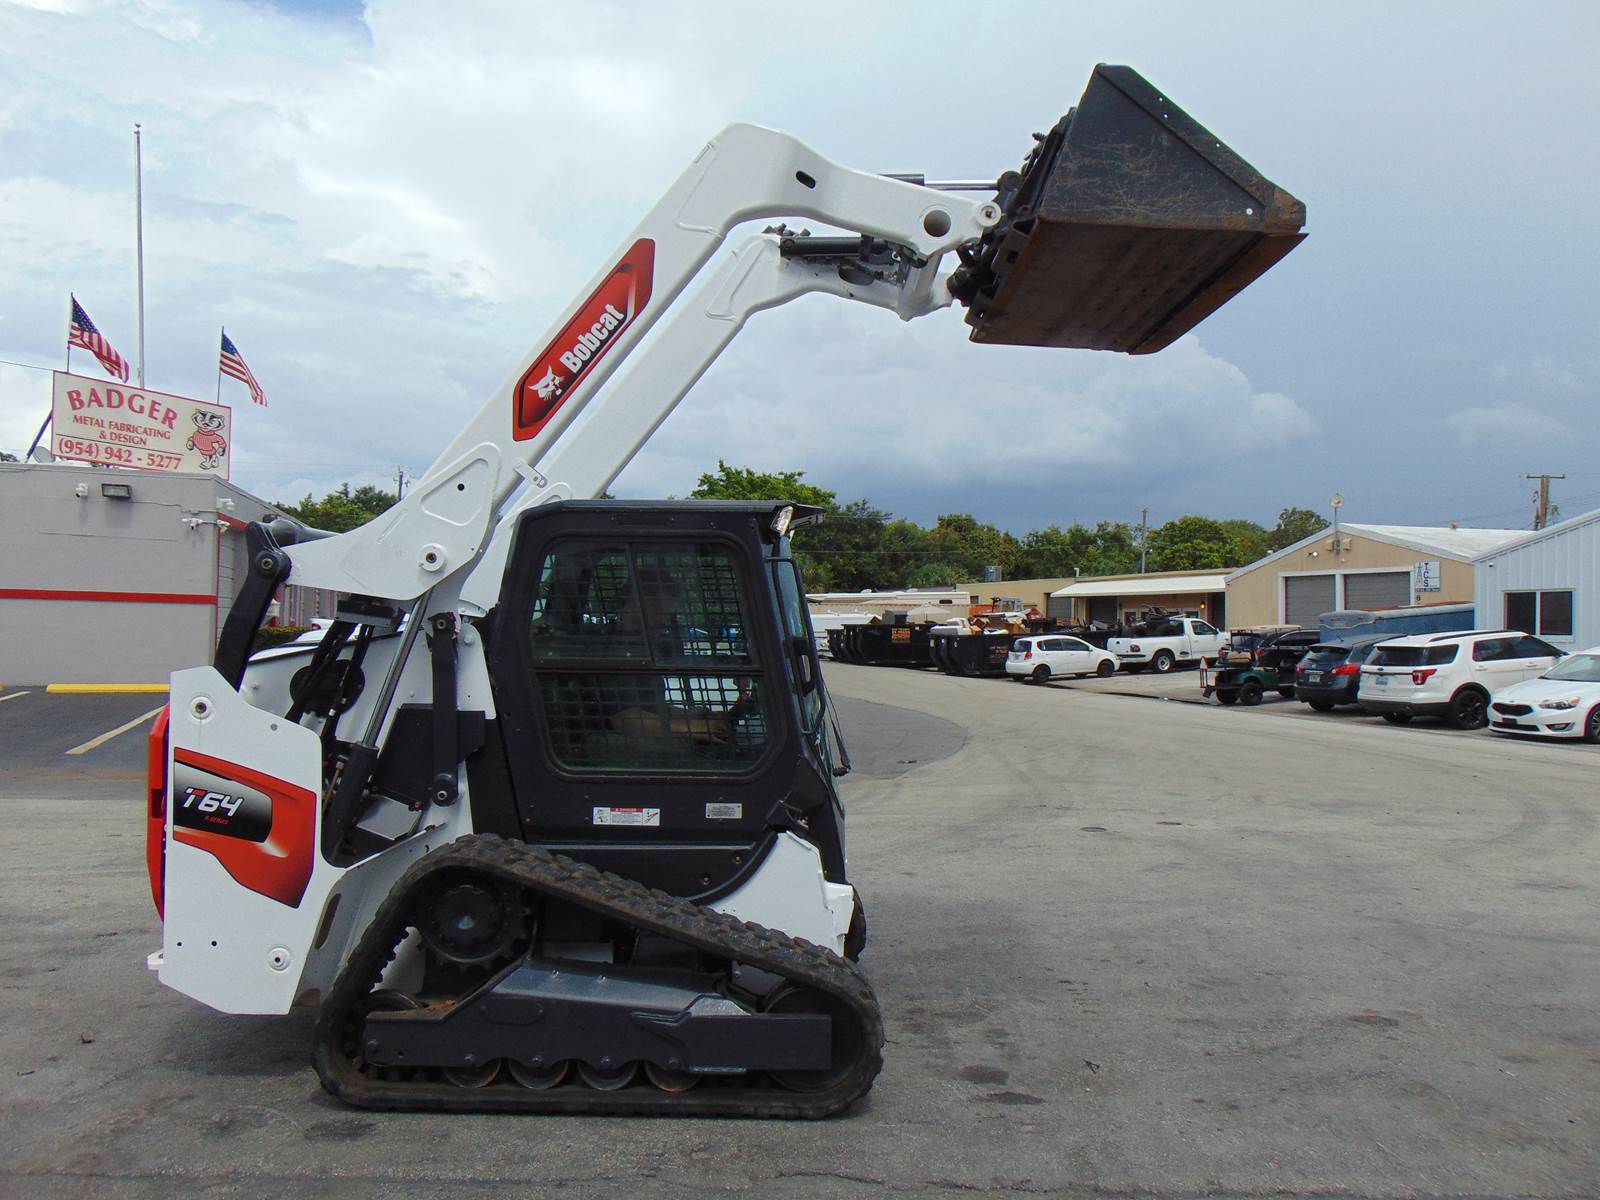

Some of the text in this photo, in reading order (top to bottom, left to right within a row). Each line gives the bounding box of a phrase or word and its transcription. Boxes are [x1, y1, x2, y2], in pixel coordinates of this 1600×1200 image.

[559, 303, 625, 374] Bobcat
[67, 388, 178, 430] BADGER
[72, 414, 171, 440] METAL FABRICATING
[99, 431, 147, 446] & DESIGN
[59, 437, 99, 458] (954)
[104, 446, 133, 463] 942
[147, 453, 182, 470] 5277
[183, 788, 243, 817] T64
